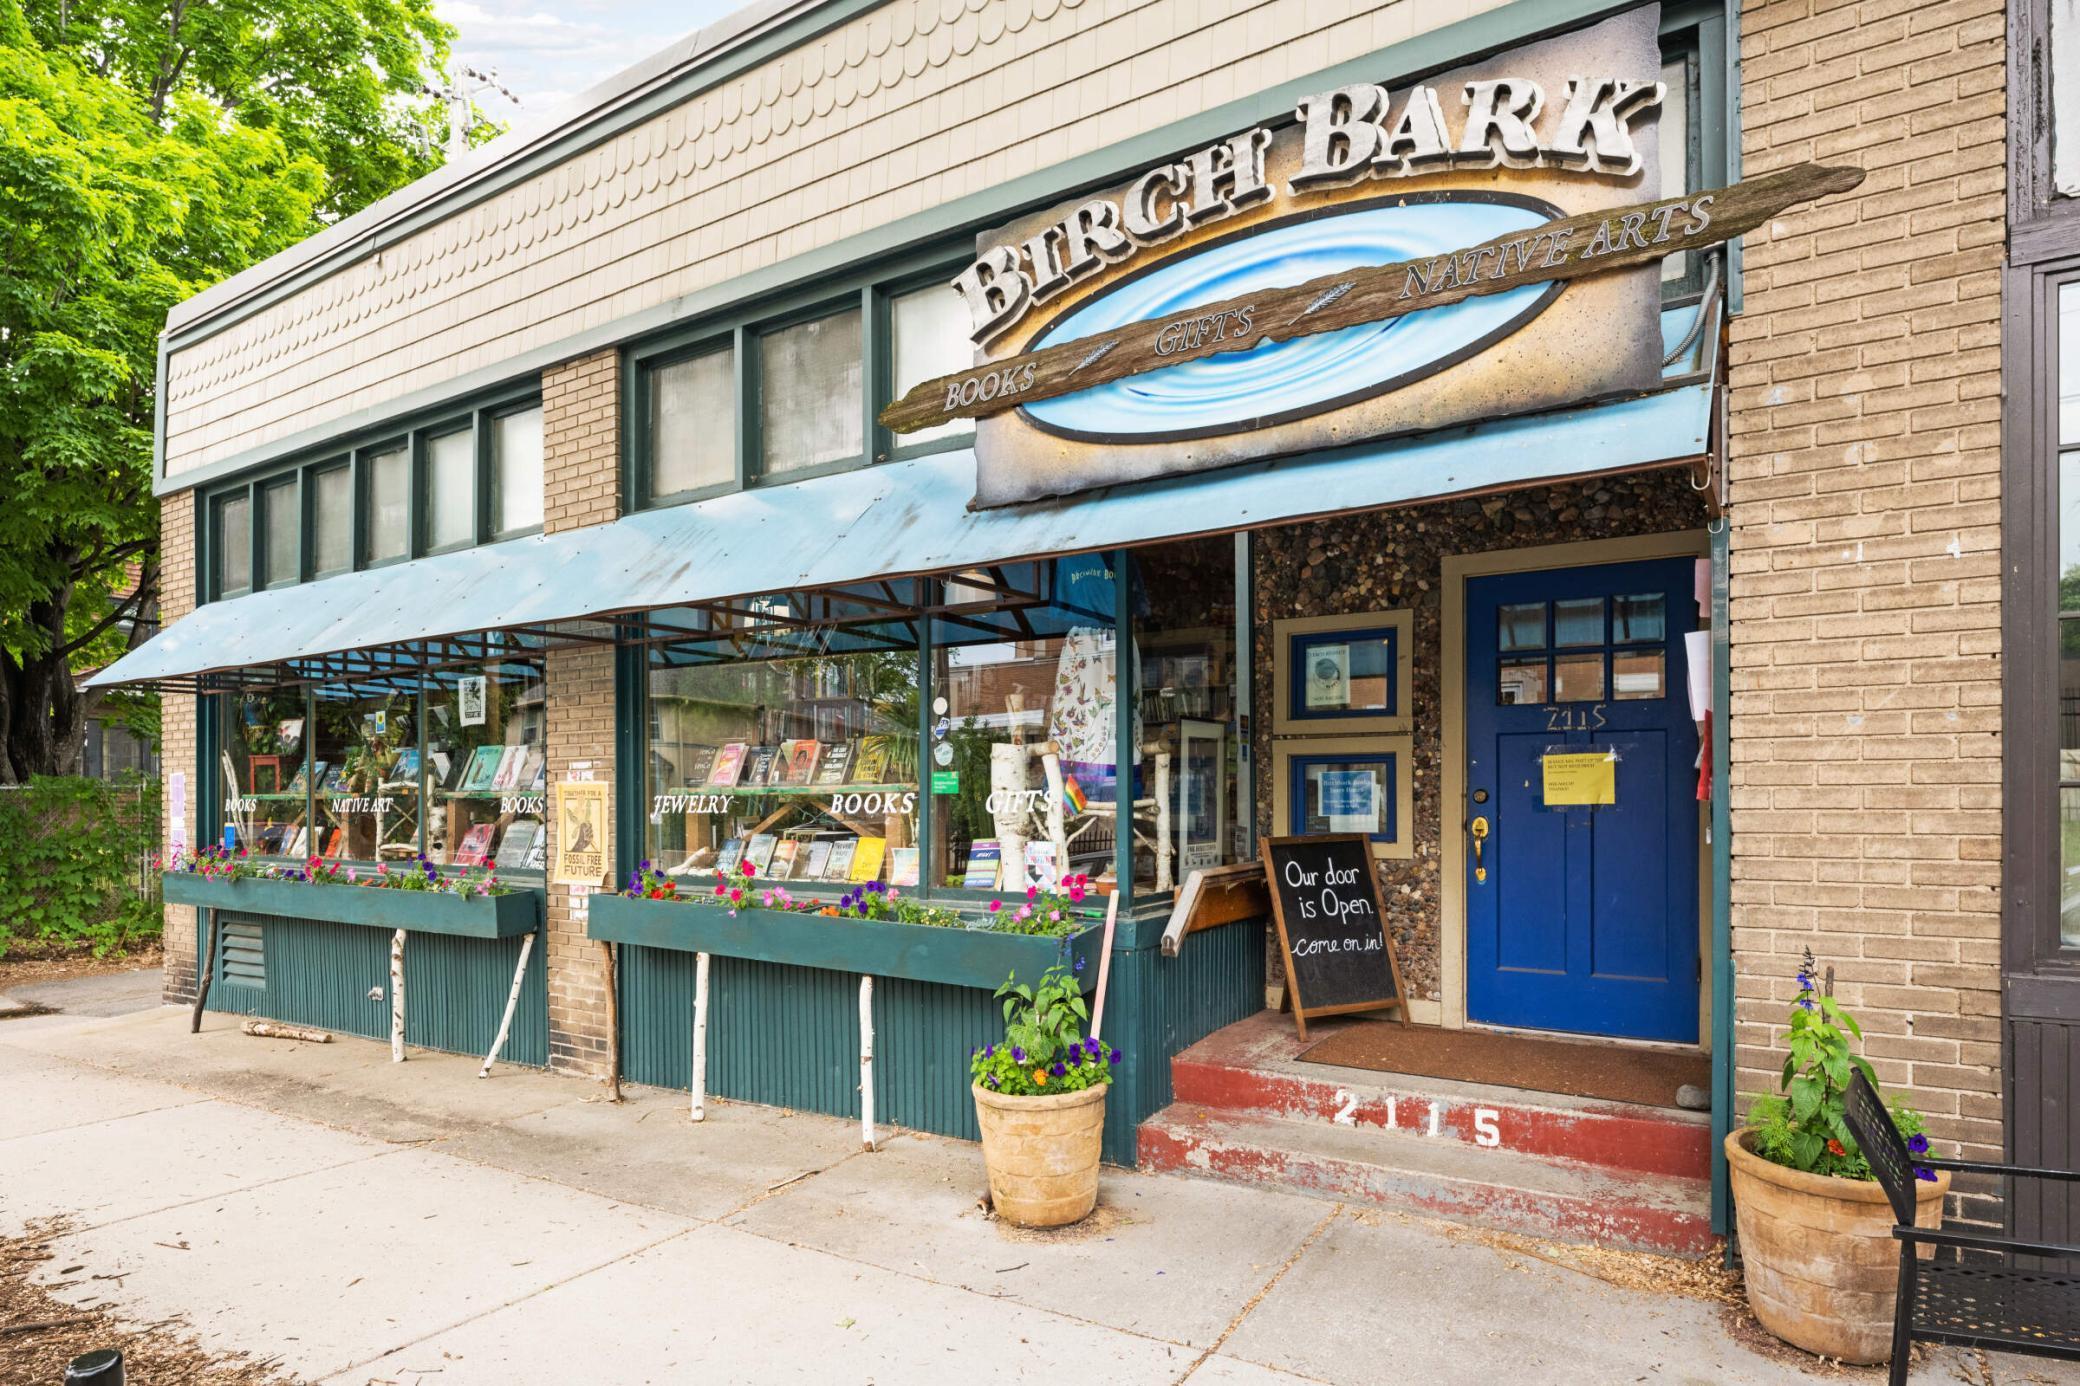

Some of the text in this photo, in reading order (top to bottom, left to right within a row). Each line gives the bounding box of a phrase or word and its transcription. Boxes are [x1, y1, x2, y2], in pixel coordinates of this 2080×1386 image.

[951, 77, 1667, 348] BIRCH BARK
[1399, 195, 1714, 300] NATIVE ARTS
[1152, 305, 1257, 358] GIFTS
[944, 362, 1037, 412] BOOKS
[1542, 704, 1608, 731] 2115
[224, 799, 257, 812] BOOKS
[331, 798, 393, 814] NATIVE ART
[500, 796, 544, 815] BOOKS
[650, 795, 734, 818] JEWELRY
[831, 792, 915, 815] BOOKS
[985, 789, 1054, 815] GIFTS
[564, 854, 602, 865] FOSSIL FREE
[565, 865, 602, 877] FUTURE
[1286, 857, 1359, 887] Our door
[1299, 896, 1317, 919] is
[1290, 932, 1383, 957] come on in!
[1333, 1088, 1500, 1147] 2115
